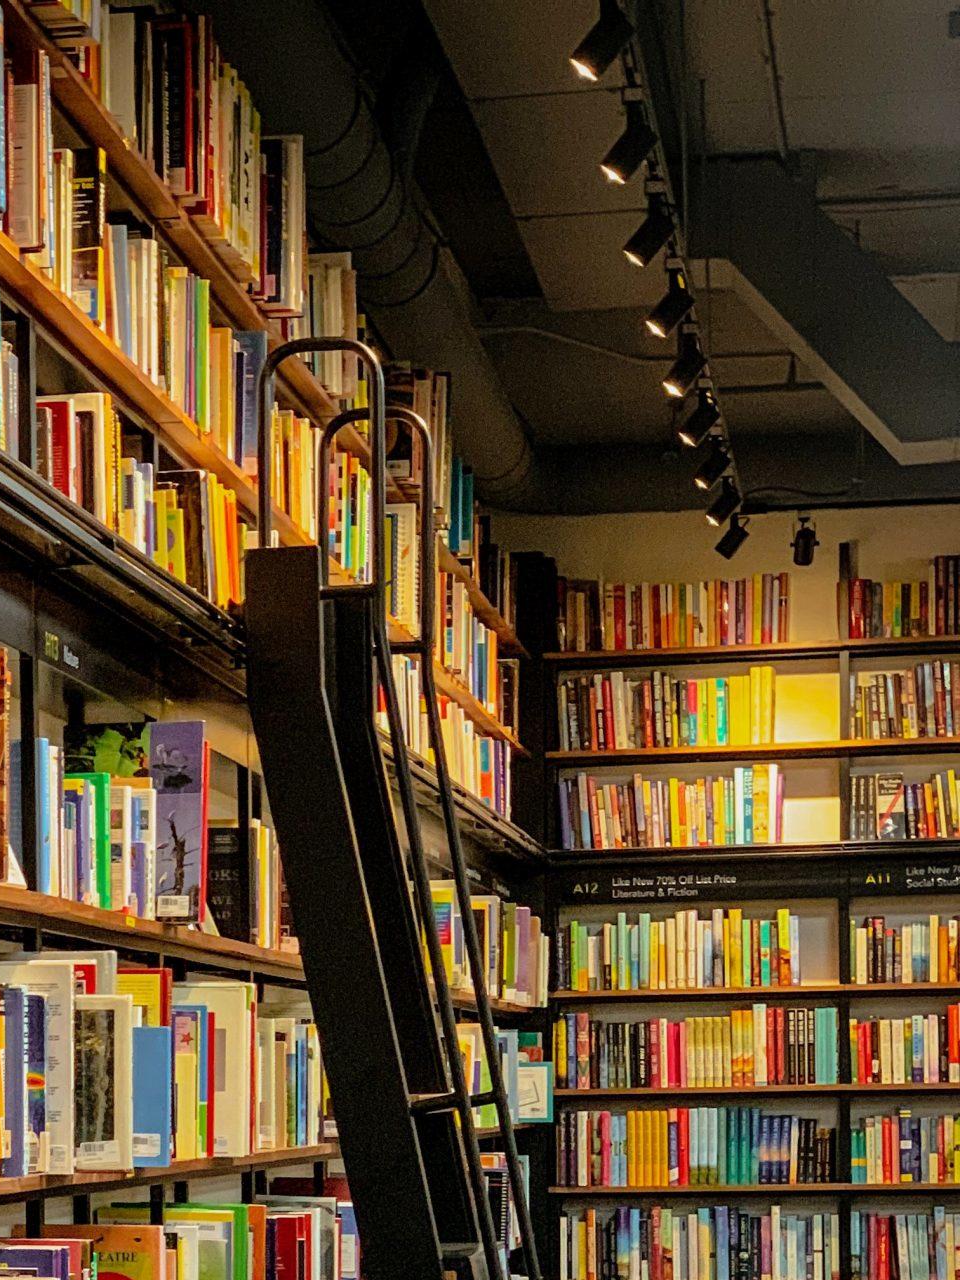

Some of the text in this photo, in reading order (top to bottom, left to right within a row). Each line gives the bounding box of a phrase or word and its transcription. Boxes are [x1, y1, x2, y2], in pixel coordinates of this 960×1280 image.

[906, 866, 925, 877] Like
[927, 865, 950, 876] New
[573, 882, 599, 895] A12
[612, 875, 630, 887] Like
[632, 875, 654, 886] New
[695, 873, 712, 885] List
[713, 872, 737, 884] Price
[866, 873, 891, 884] A11
[906, 879, 935, 889] Social
[611, 886, 699, 900] Literature & Fiction
